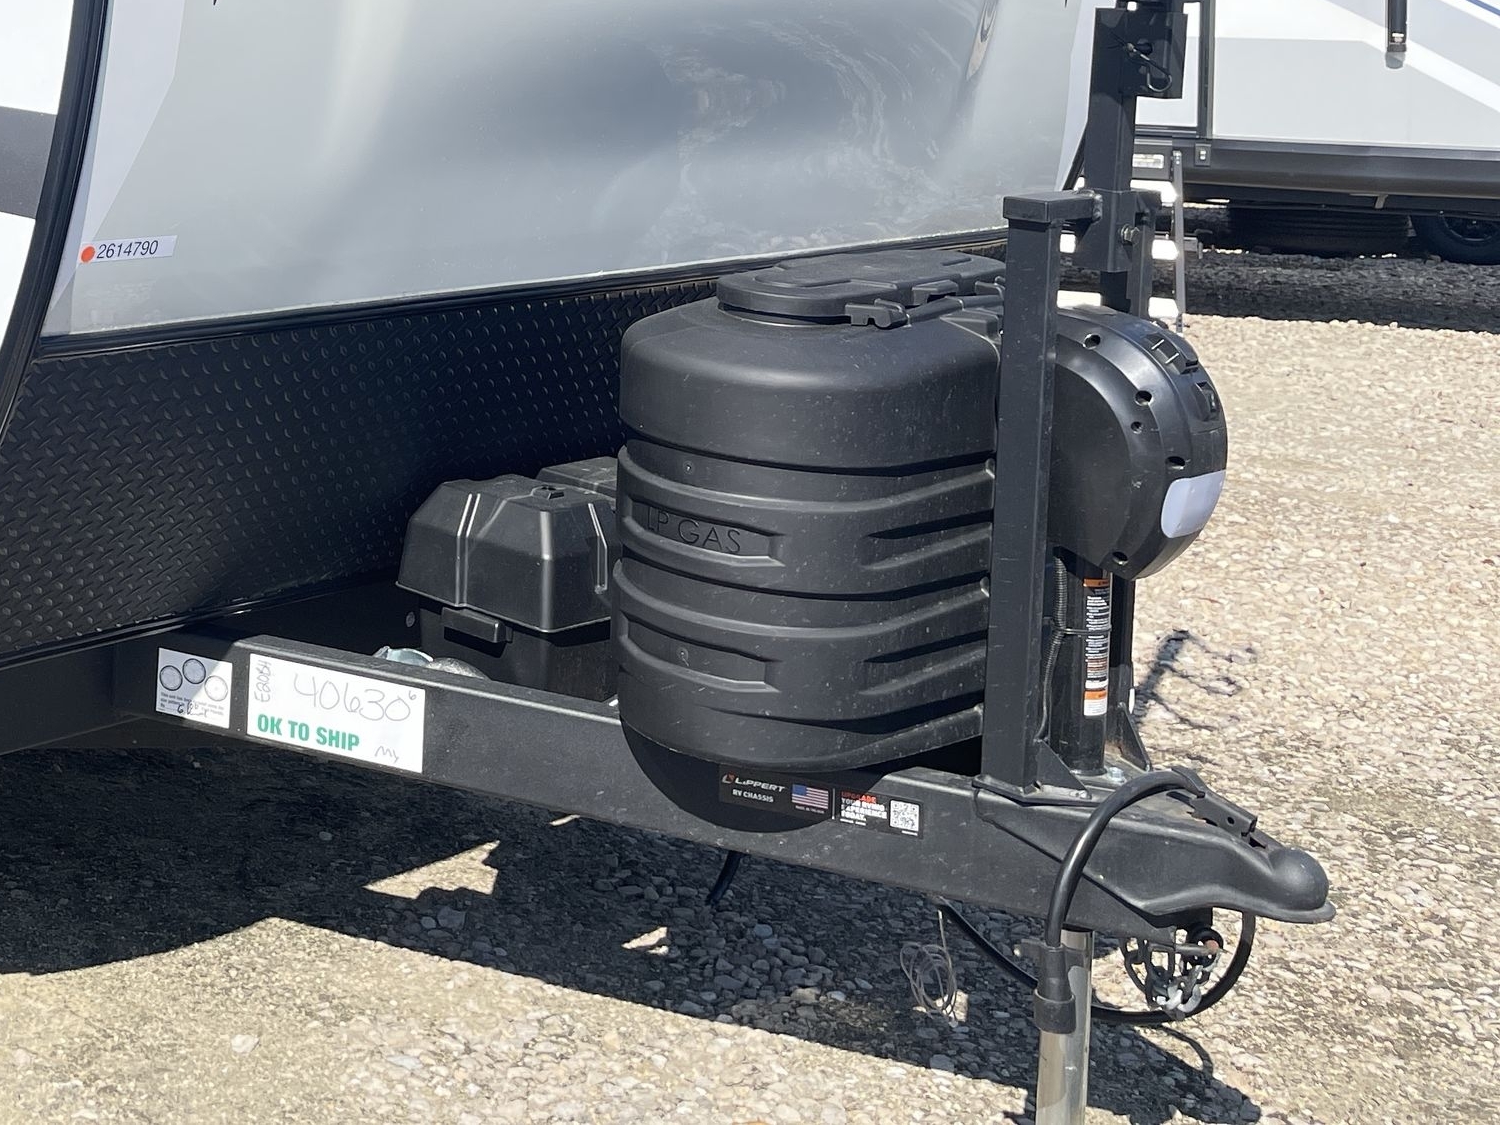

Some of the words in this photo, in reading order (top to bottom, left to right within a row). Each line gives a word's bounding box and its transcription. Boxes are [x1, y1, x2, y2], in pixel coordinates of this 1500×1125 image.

[96, 239, 159, 259] 2614790
[677, 518, 741, 554] GAS
[257, 713, 283, 737] OK
[288, 720, 310, 742] TO
[316, 726, 360, 752] SHIP
[732, 789, 742, 798] RV
[742, 791, 774, 804] CHASSIS
